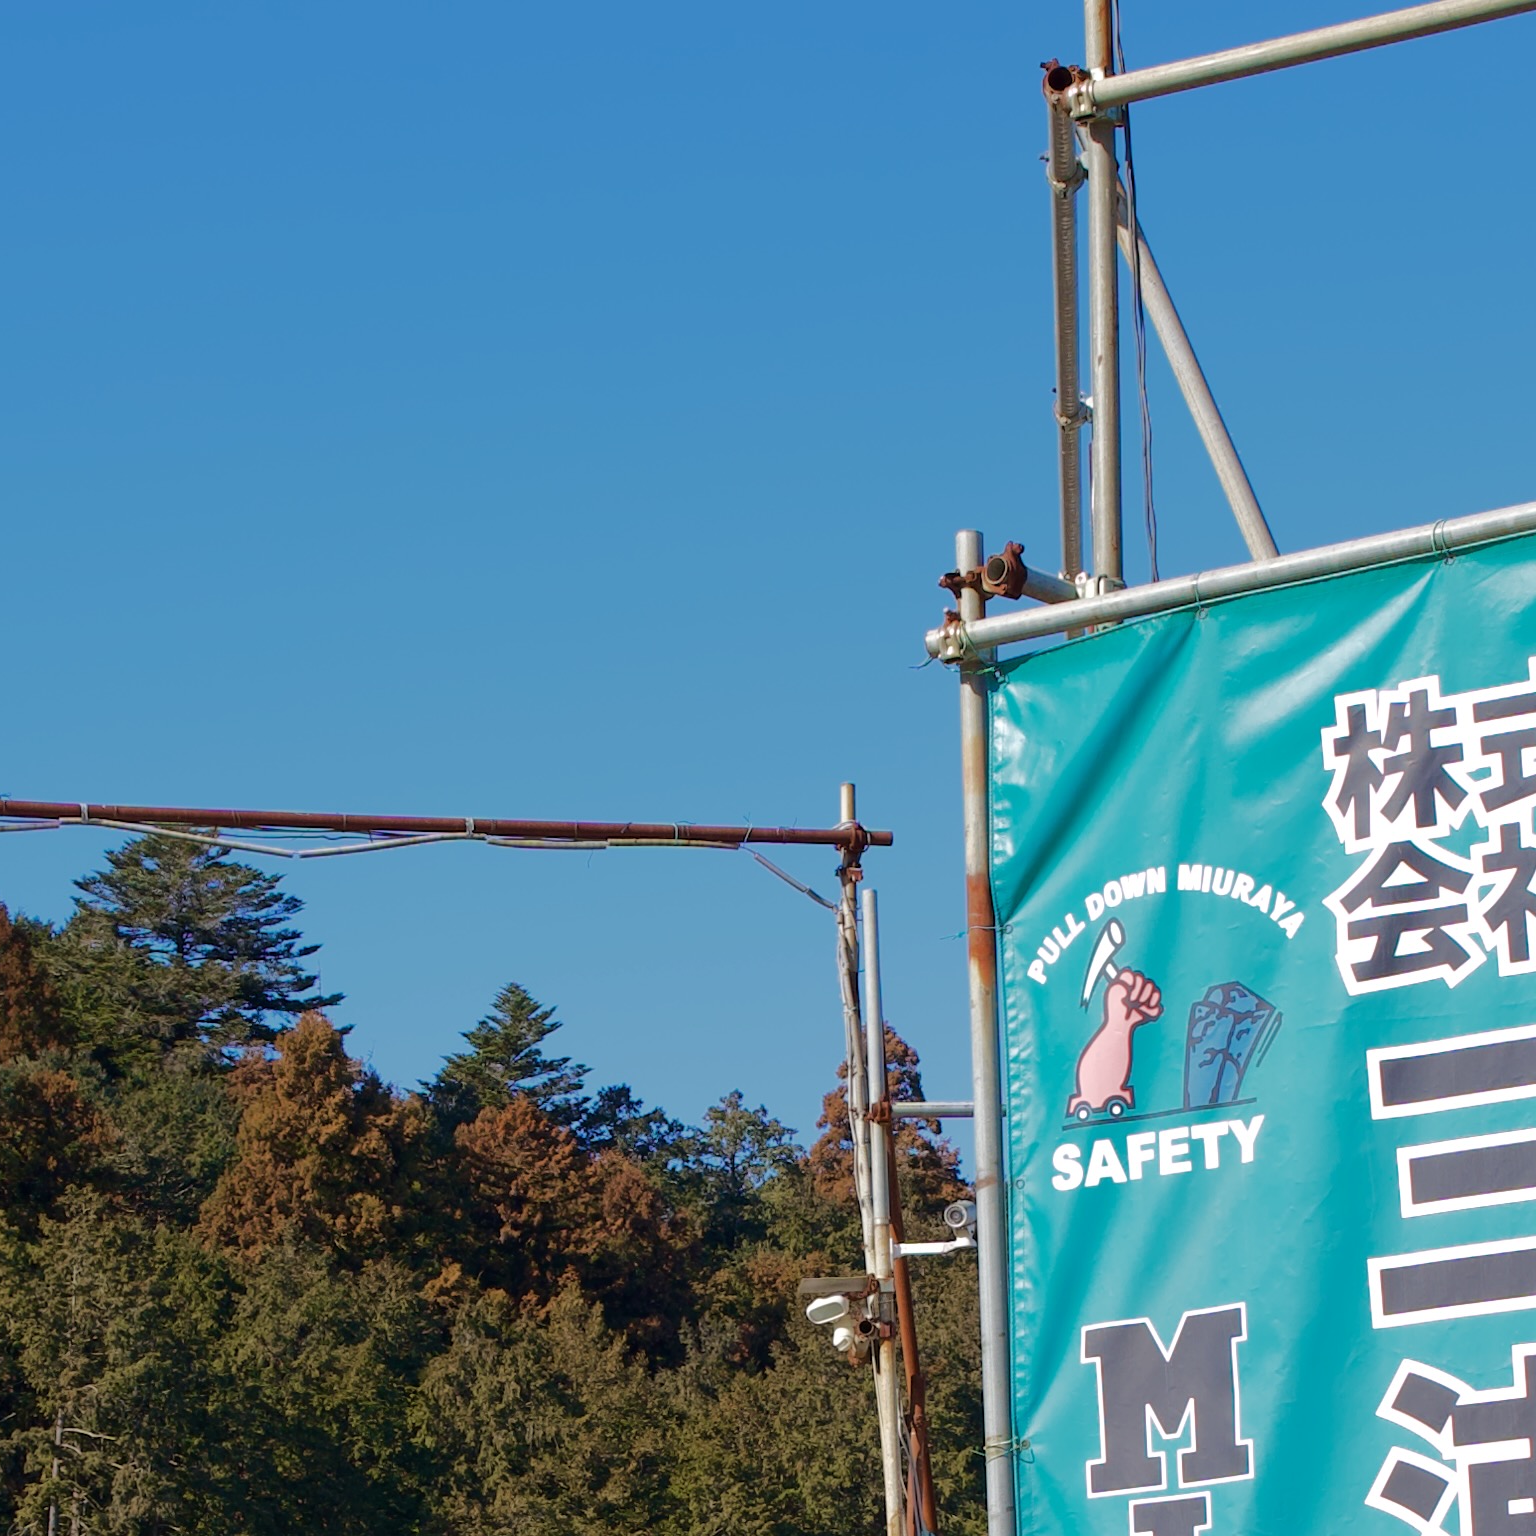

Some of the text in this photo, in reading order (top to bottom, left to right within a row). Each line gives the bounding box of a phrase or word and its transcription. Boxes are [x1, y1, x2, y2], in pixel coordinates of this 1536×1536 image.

[1027, 863, 1306, 985] PULL DOWN MIURAYA
[1051, 1114, 1265, 1192] SAFETY
